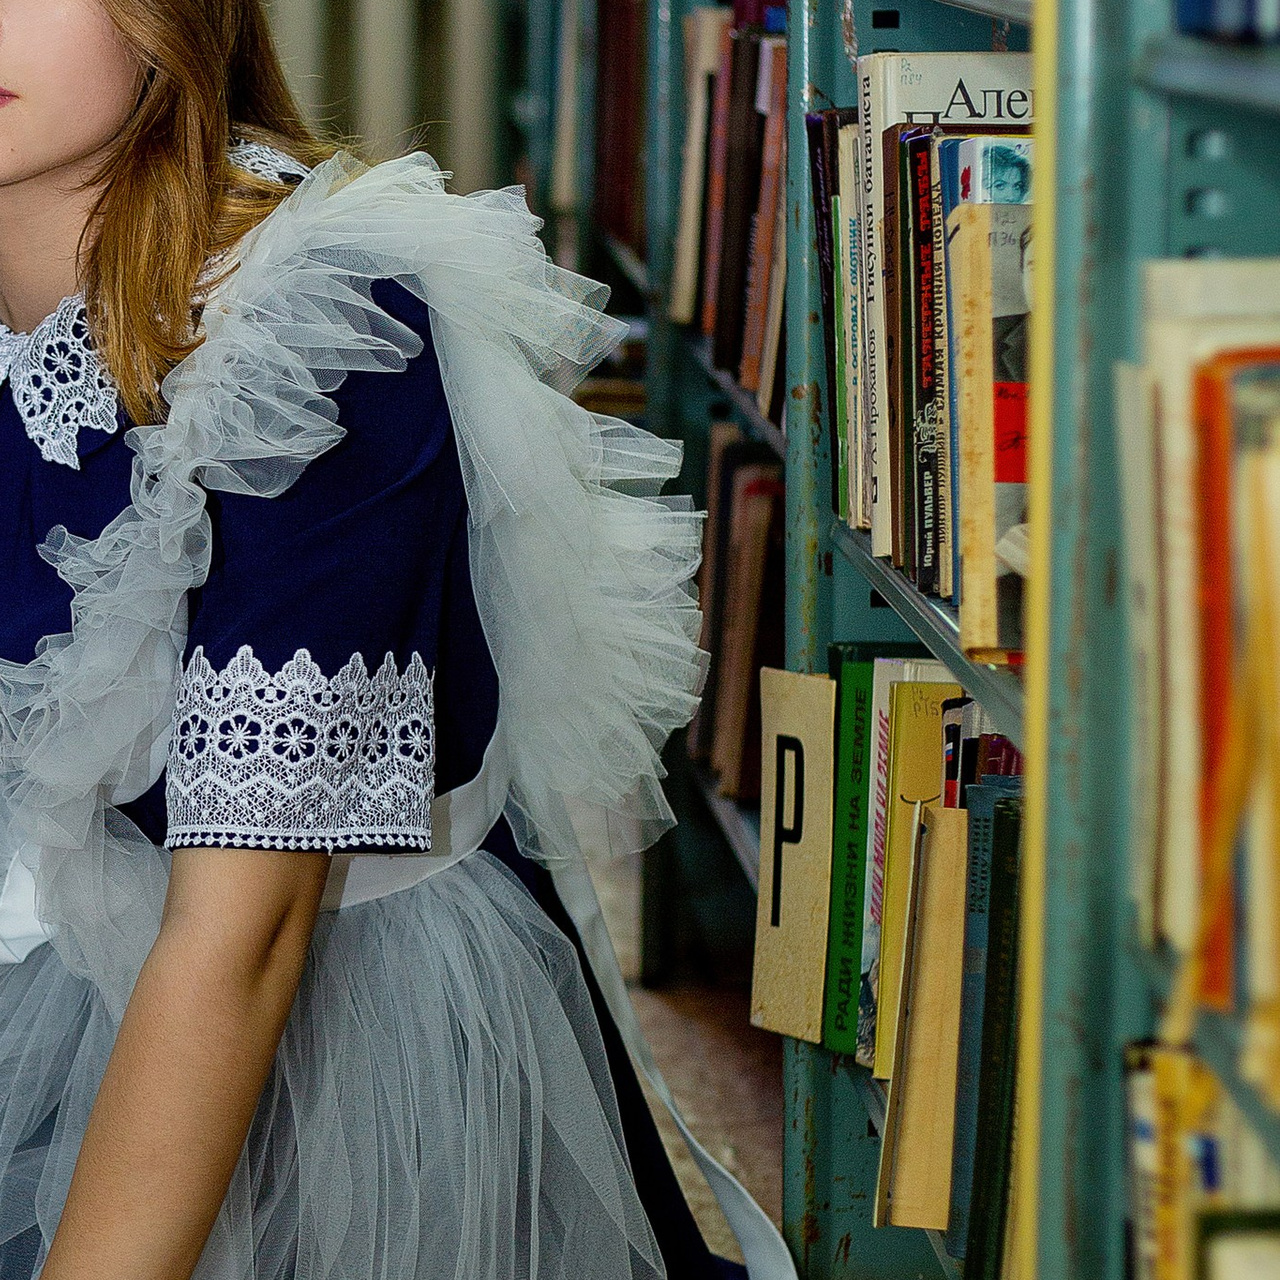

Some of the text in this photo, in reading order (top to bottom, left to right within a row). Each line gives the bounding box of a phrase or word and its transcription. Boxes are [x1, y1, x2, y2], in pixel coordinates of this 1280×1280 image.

[863, 73, 873, 194] баталиста
[924, 470, 933, 528] ПУЛЬВЕР
[924, 531, 934, 568] Юрий
[771, 733, 804, 928] Р
[834, 686, 866, 1032] РАДИ ЖИЗНИ НА ЗЕМЛЕ
